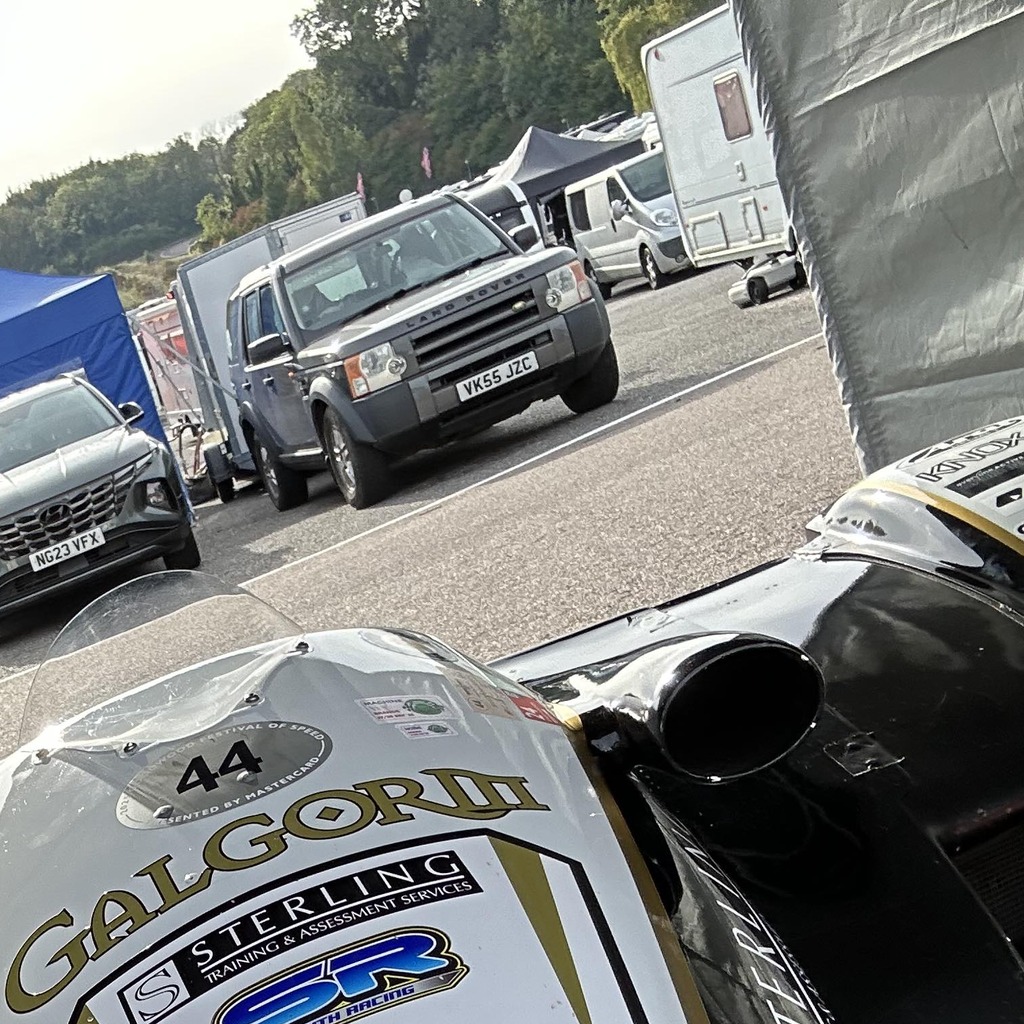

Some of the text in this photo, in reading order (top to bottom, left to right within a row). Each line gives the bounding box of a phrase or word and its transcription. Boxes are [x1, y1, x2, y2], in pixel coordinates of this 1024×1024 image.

[405, 272, 526, 328] LAND ROVER
[463, 356, 533, 396] VK55 JZC
[35, 531, 100, 568] NG23 VFX
[268, 721, 287, 731] OF
[288, 722, 326, 742] SPEED
[175, 739, 263, 795] 44
[224, 796, 241, 810] BY
[244, 755, 321, 801] MASTERCARD
[190, 853, 463, 969] STERLING
[203, 880, 473, 984] TRAINING & ASSESSMENT SERVICES
[346, 984, 415, 1016] RACING
